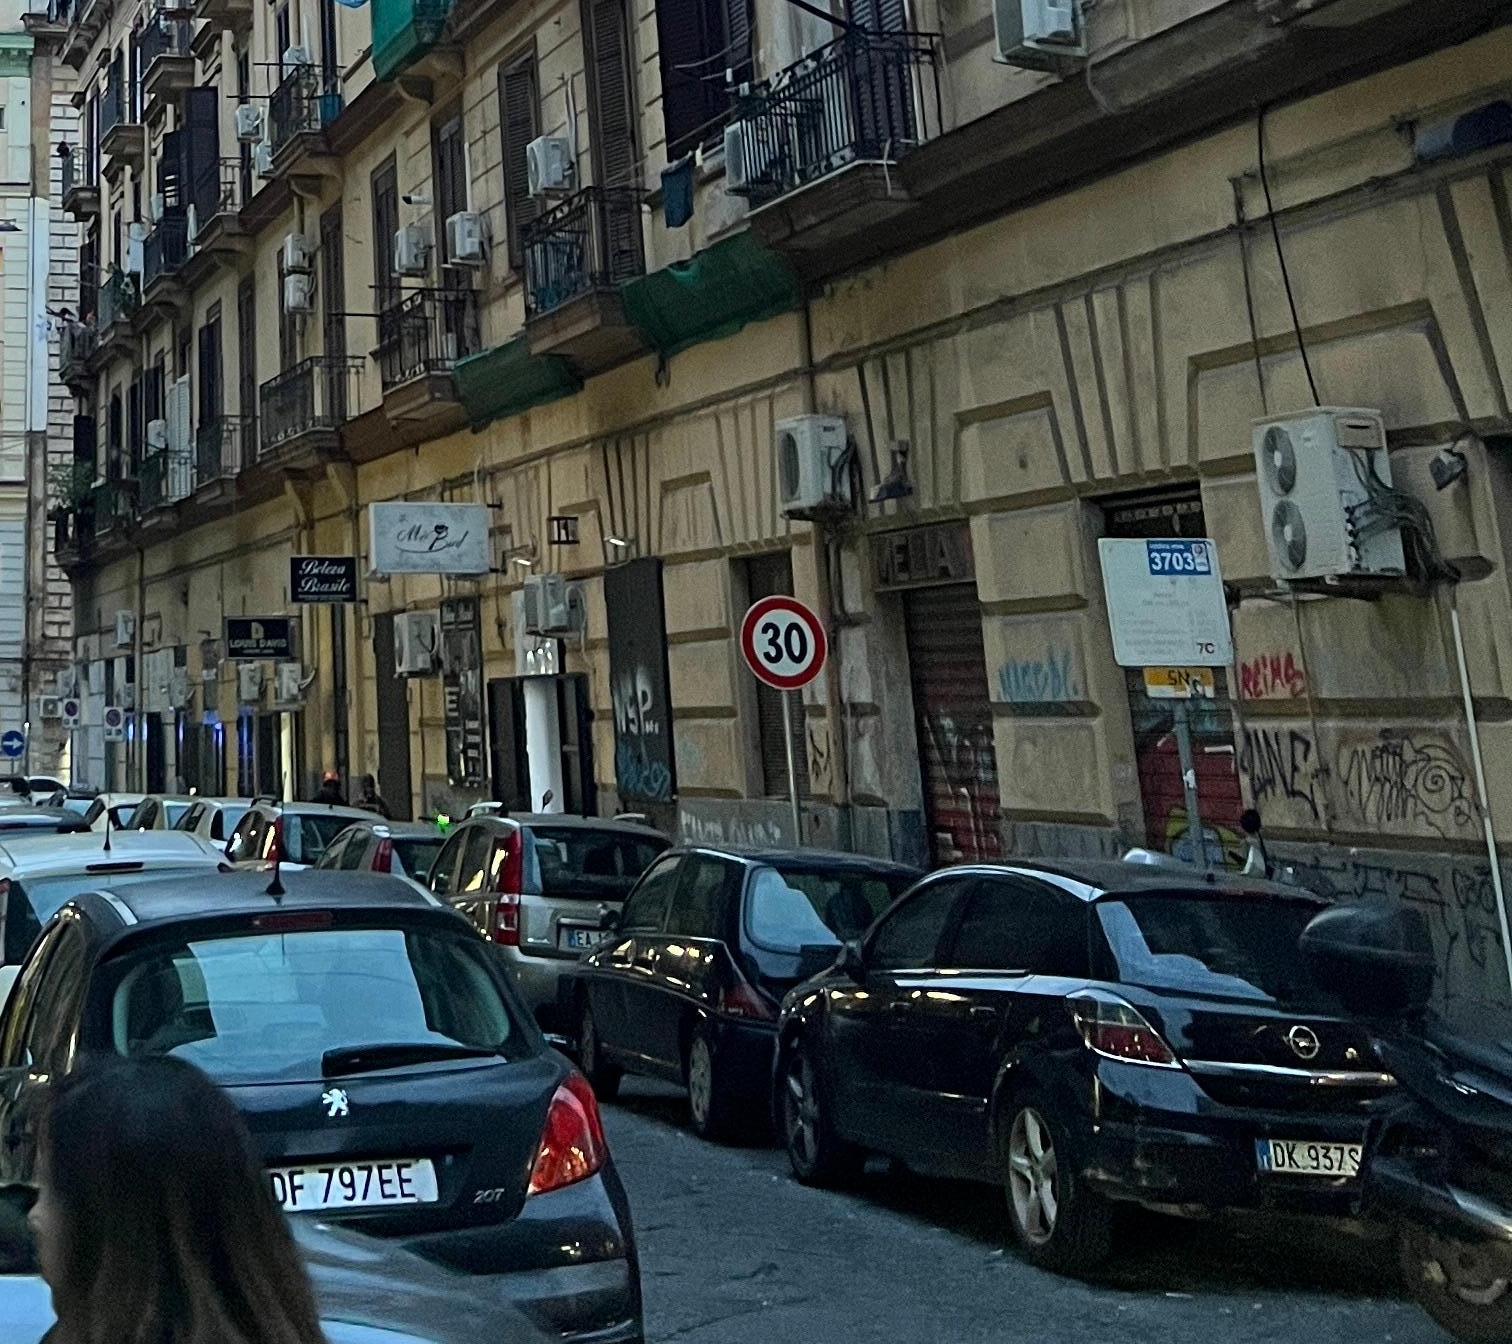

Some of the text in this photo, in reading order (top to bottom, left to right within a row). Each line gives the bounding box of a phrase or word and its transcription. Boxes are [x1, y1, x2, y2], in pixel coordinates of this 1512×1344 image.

[761, 622, 808, 664] 30
[1196, 642, 1217, 654] 7C
[1273, 1142, 1301, 1169] DK
[319, 1163, 416, 1203] 797EE
[473, 1188, 505, 1204] 207
